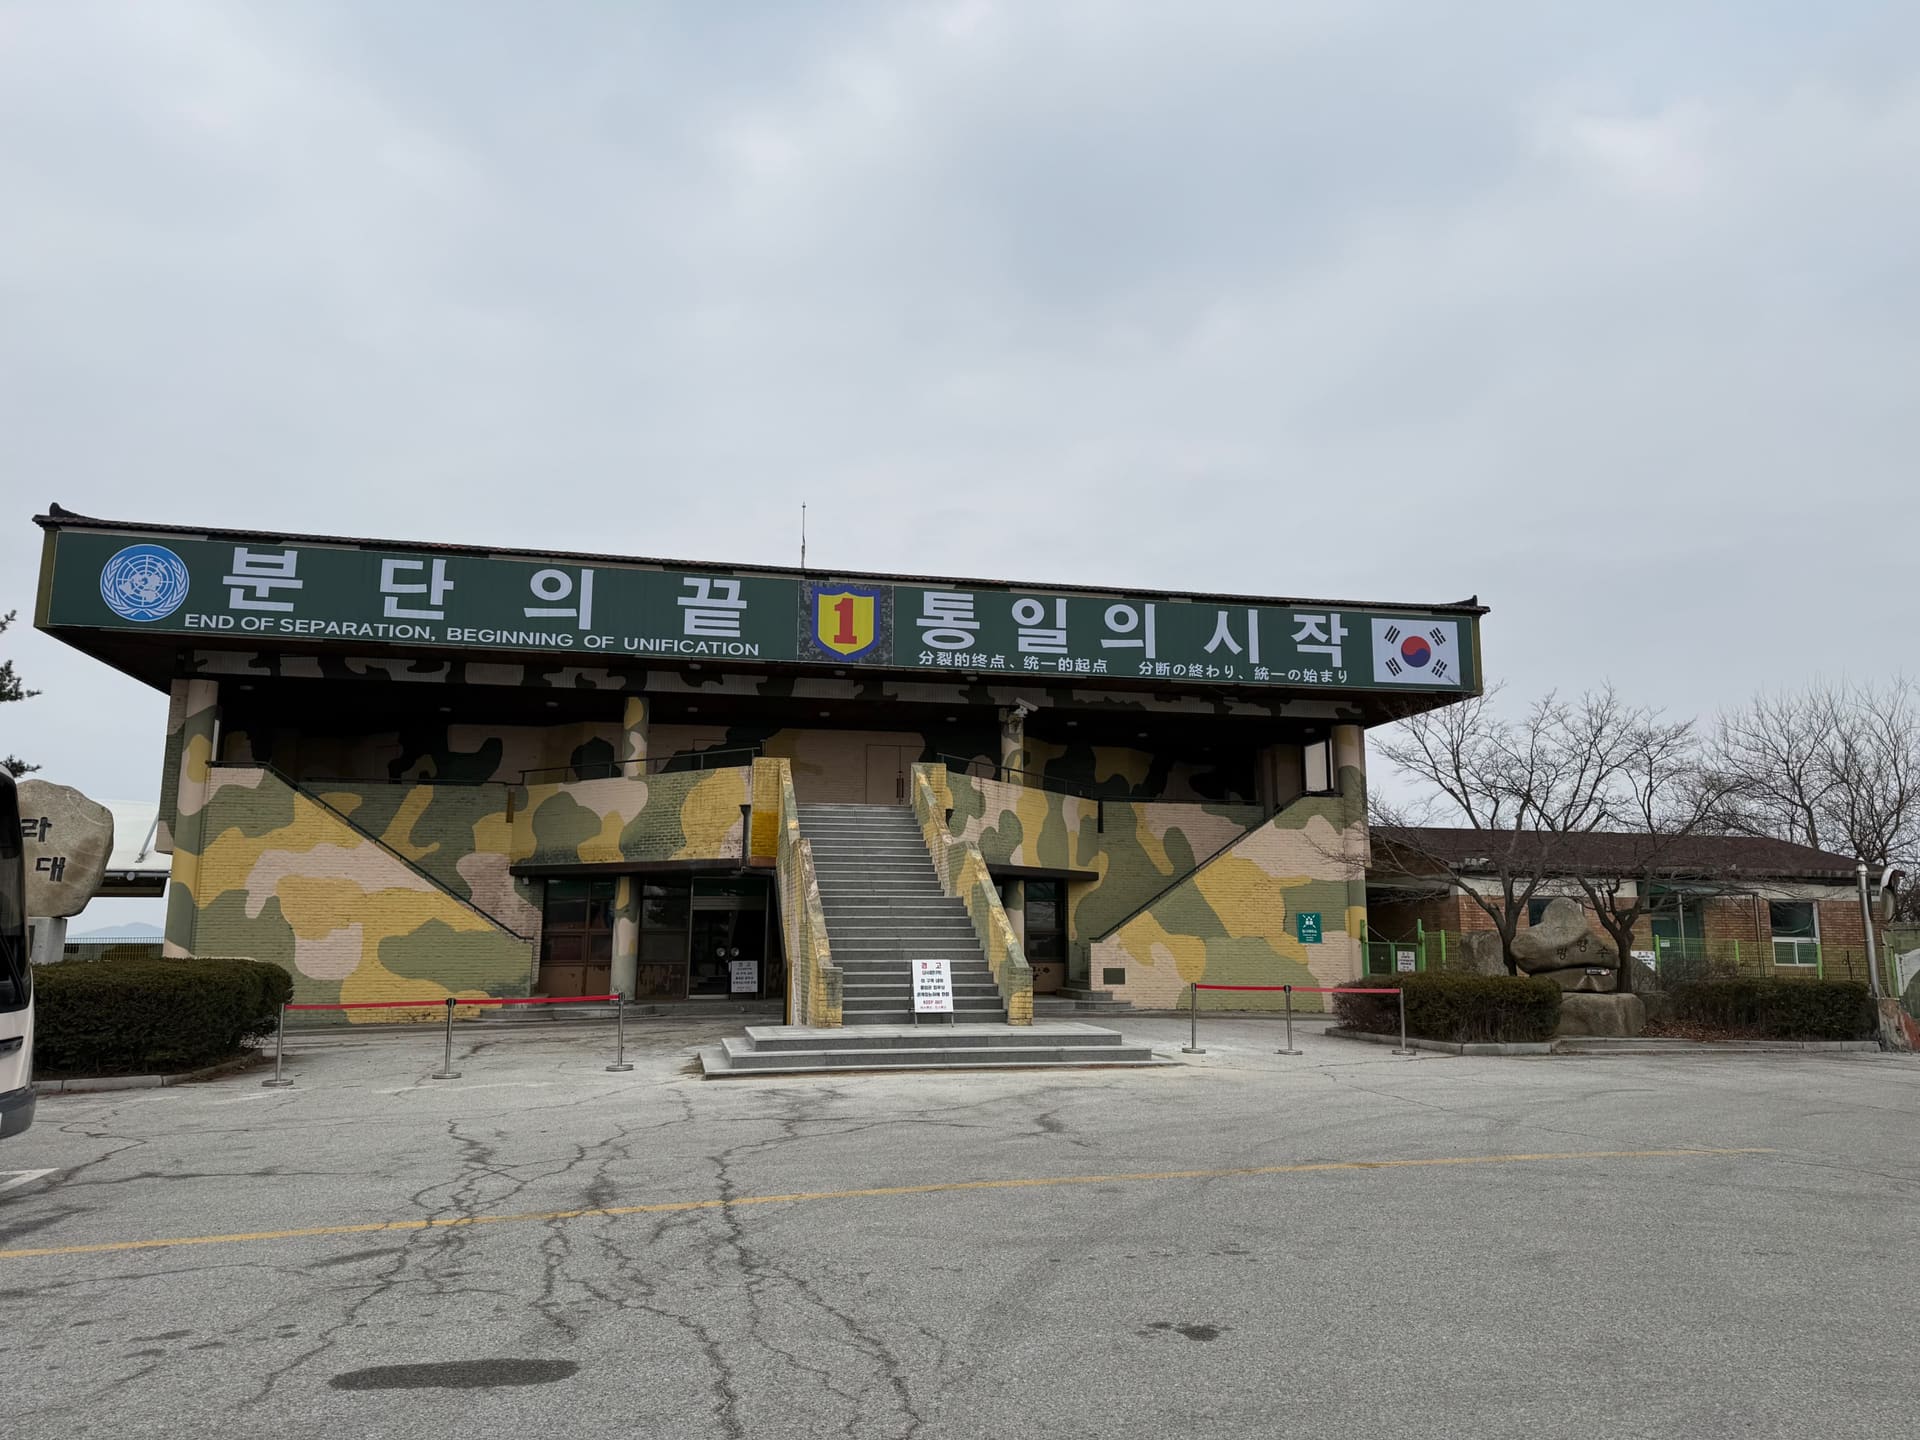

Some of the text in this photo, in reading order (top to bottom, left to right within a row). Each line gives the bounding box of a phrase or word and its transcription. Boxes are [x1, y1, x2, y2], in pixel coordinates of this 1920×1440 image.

[677, 577, 747, 639] 끝
[185, 614, 760, 657] END OF SEPARATION, BEGINNING OF UNIFICATION
